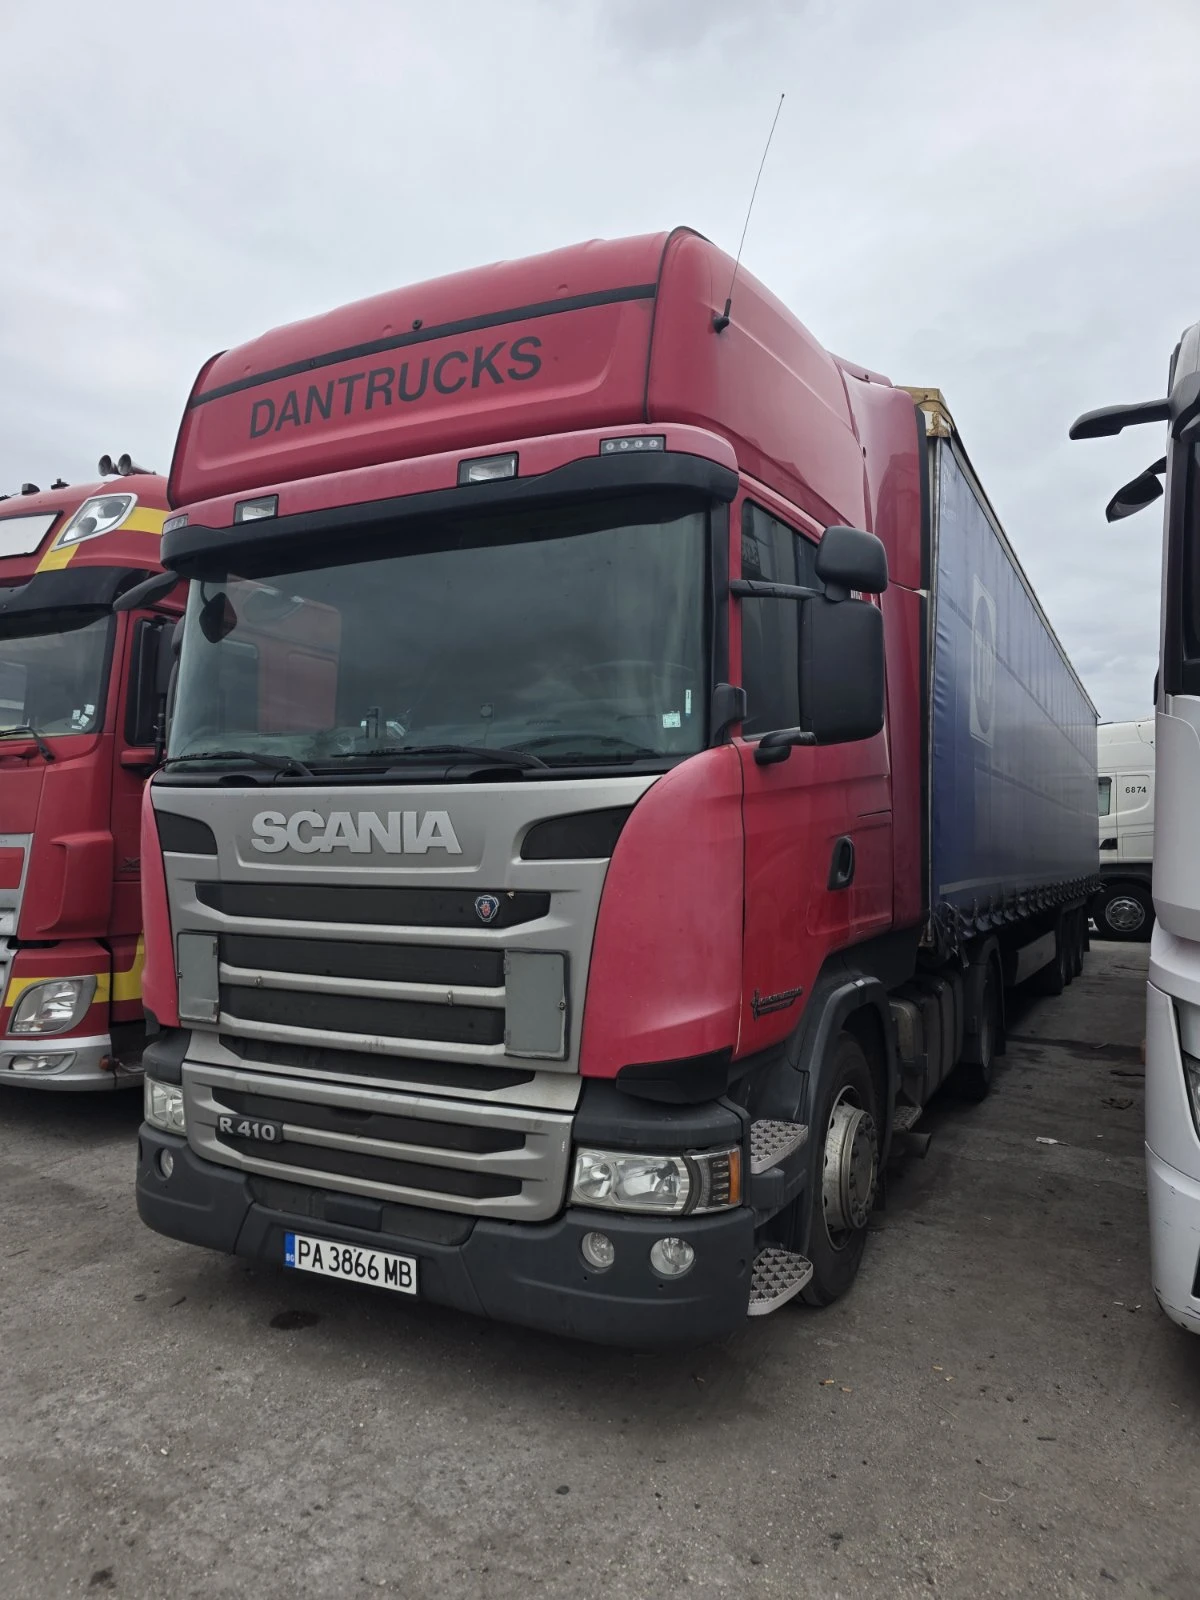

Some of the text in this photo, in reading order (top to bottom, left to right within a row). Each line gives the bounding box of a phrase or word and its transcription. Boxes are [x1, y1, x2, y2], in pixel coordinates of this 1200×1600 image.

[249, 336, 542, 439] DANTRUCKS
[1125, 786, 1147, 794] 6874
[251, 811, 463, 854] SCANIA
[219, 1116, 276, 1142] R 410
